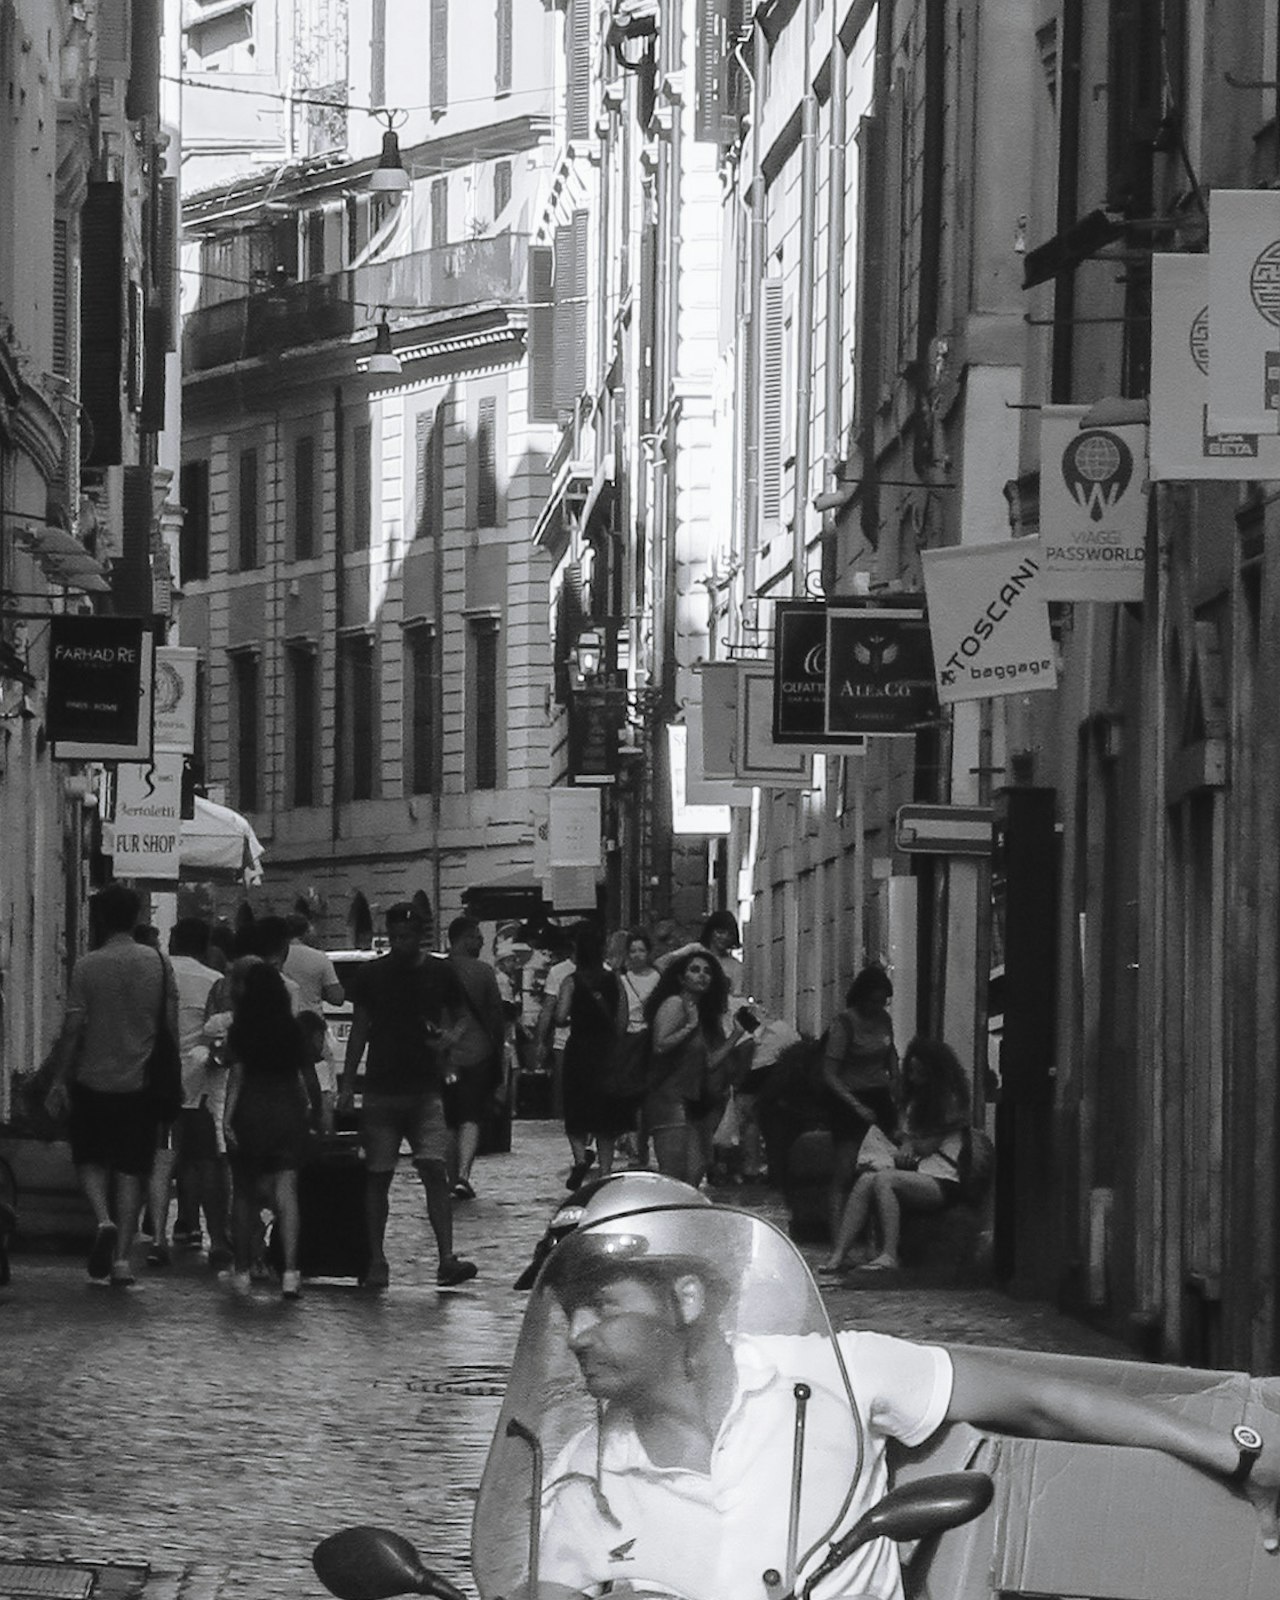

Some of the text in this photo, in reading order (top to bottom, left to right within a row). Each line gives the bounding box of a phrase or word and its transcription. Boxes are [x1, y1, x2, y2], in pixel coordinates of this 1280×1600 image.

[1046, 547, 1145, 561] PASSWORLD
[946, 558, 1039, 671] TOSCANI
[55, 645, 136, 662] FARHAD RE
[971, 659, 1051, 679] baggage
[116, 834, 176, 854] FUR SHOP
